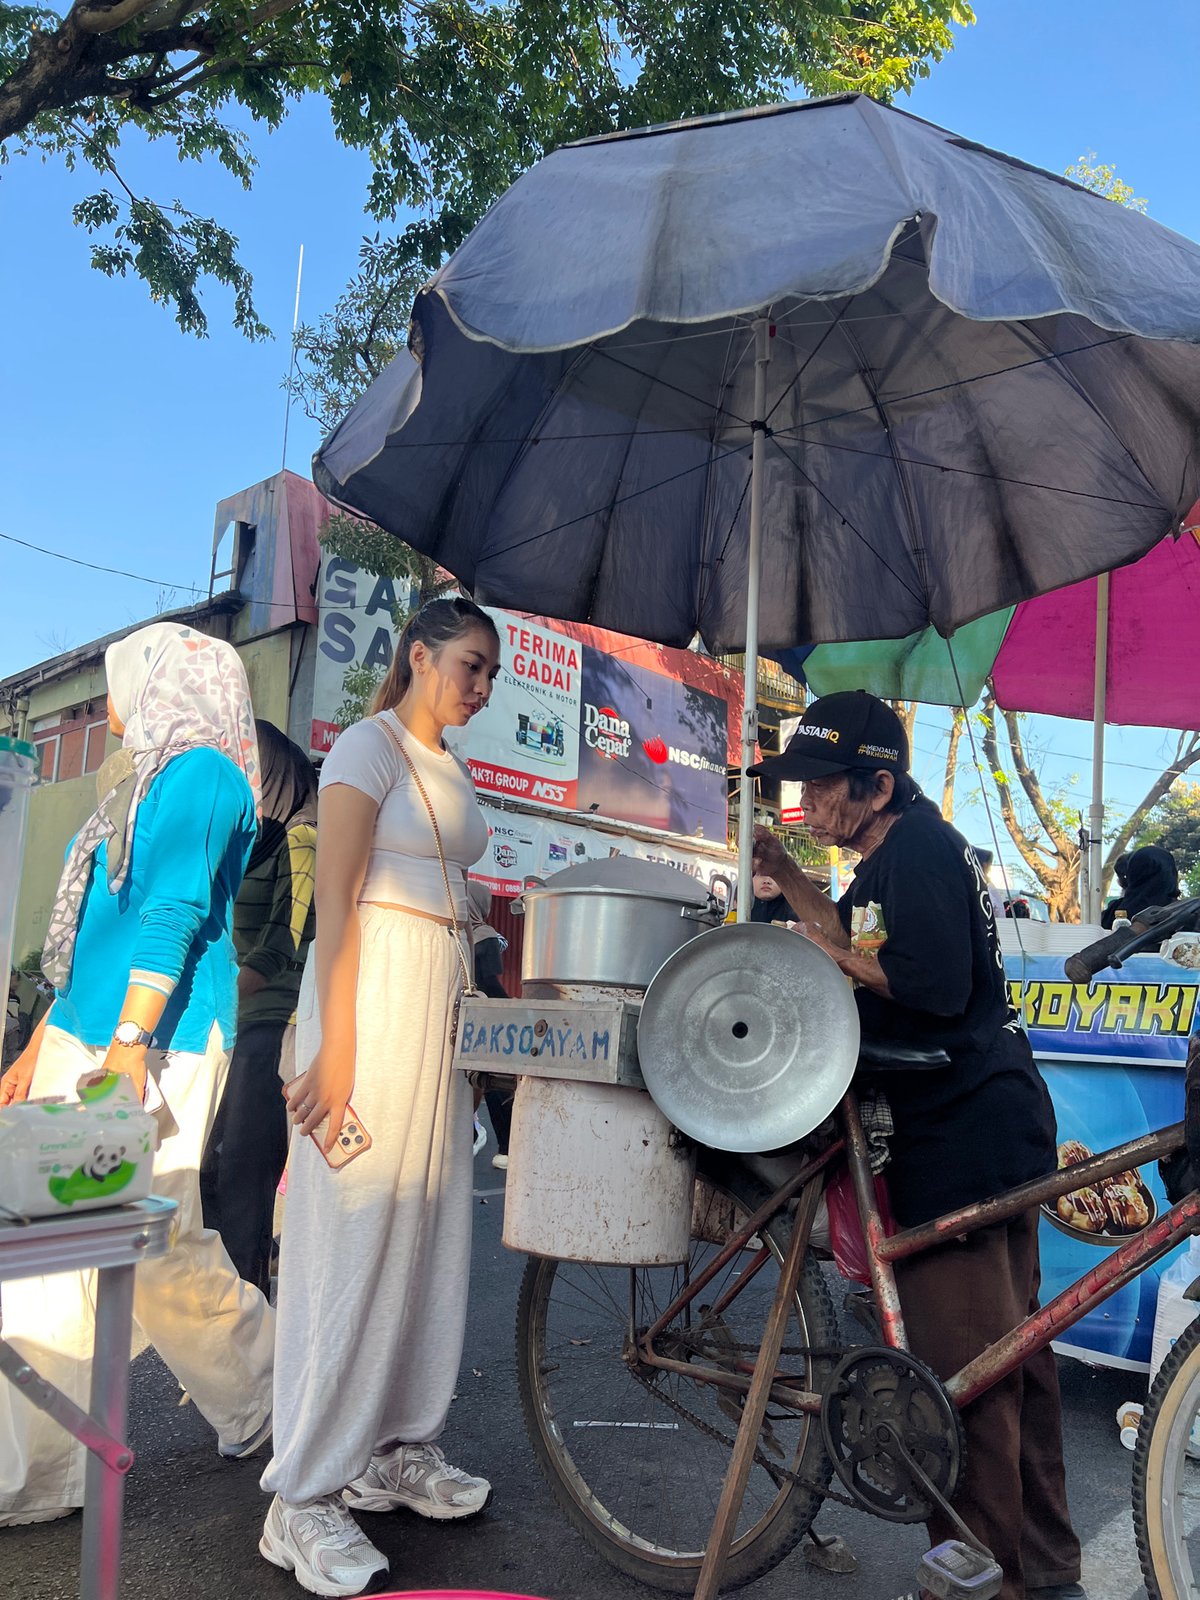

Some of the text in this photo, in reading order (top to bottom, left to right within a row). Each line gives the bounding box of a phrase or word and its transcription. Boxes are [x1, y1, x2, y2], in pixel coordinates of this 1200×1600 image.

[506, 623, 578, 671] TERIMA
[504, 675, 547, 695] ELEKTRONIK
[556, 693, 577, 706] MOTOR
[513, 653, 571, 693] GADAI
[584, 703, 631, 738] Dana
[584, 726, 632, 759] Cepat
[495, 773, 529, 792] GROUP
[461, 1021, 610, 1060] BAKSO AYAM
